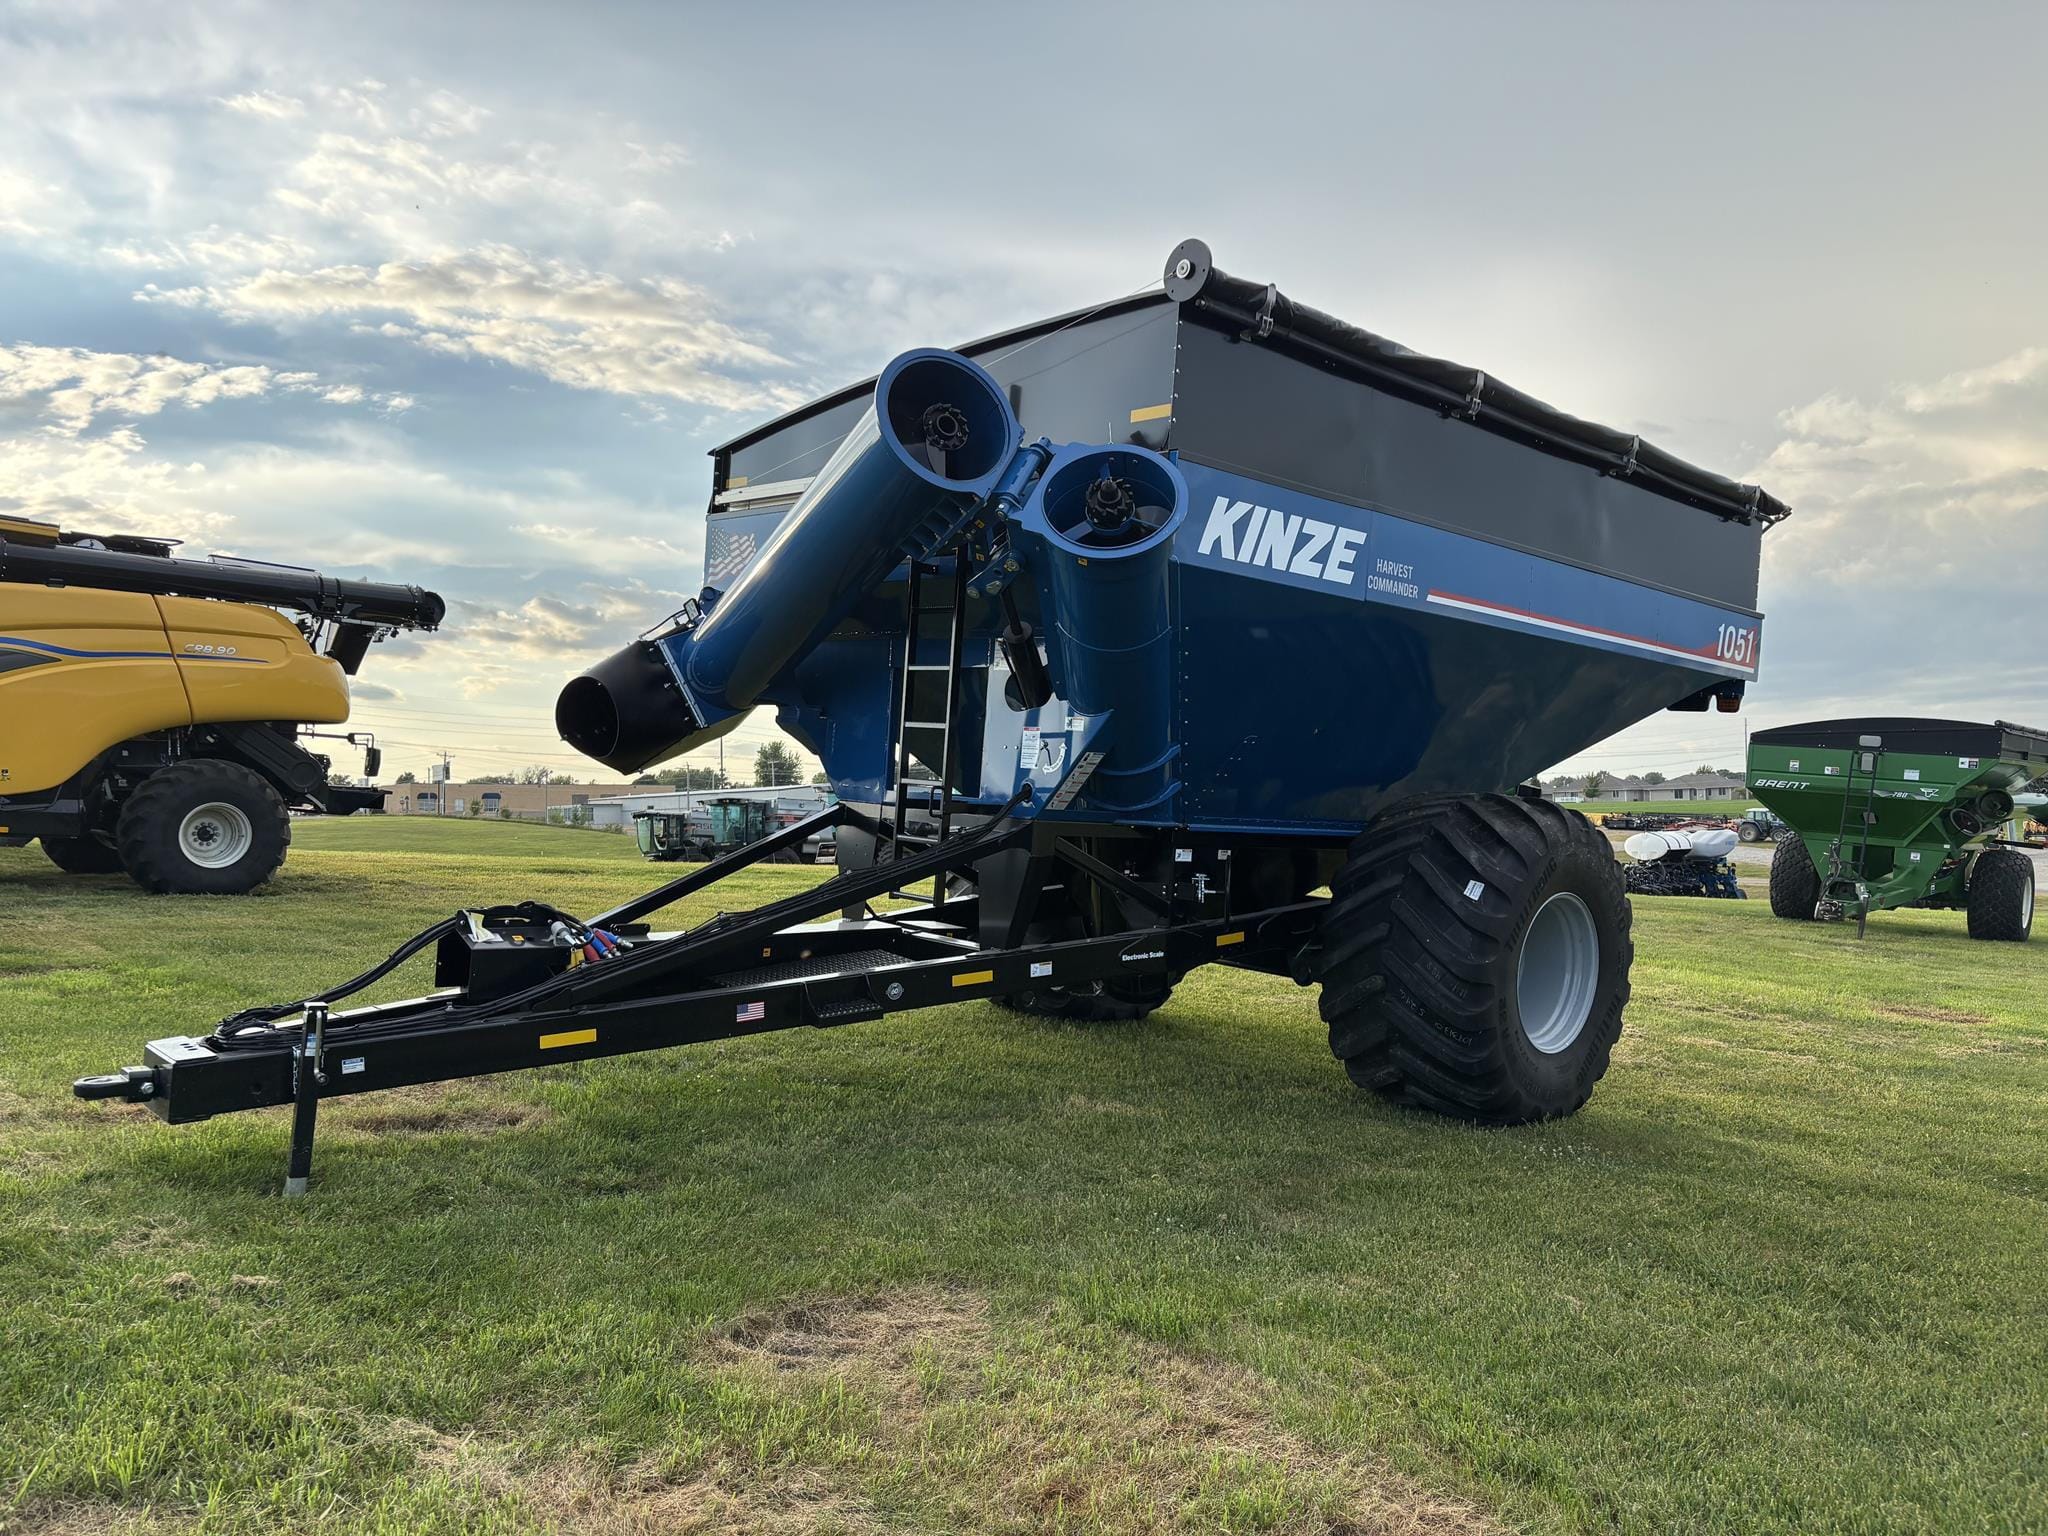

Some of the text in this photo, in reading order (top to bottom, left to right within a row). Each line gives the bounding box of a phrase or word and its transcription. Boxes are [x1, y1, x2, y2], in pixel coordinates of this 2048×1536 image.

[1198, 495, 1367, 585] KINZE
[1376, 558, 1414, 579] HARVEST
[1367, 574, 1419, 600] COMMANDER
[184, 643, 237, 656] CR8.90
[1717, 623, 1755, 664] 1051
[1754, 779, 1811, 790] BRENT
[1121, 950, 1165, 962] Electronic Scale
